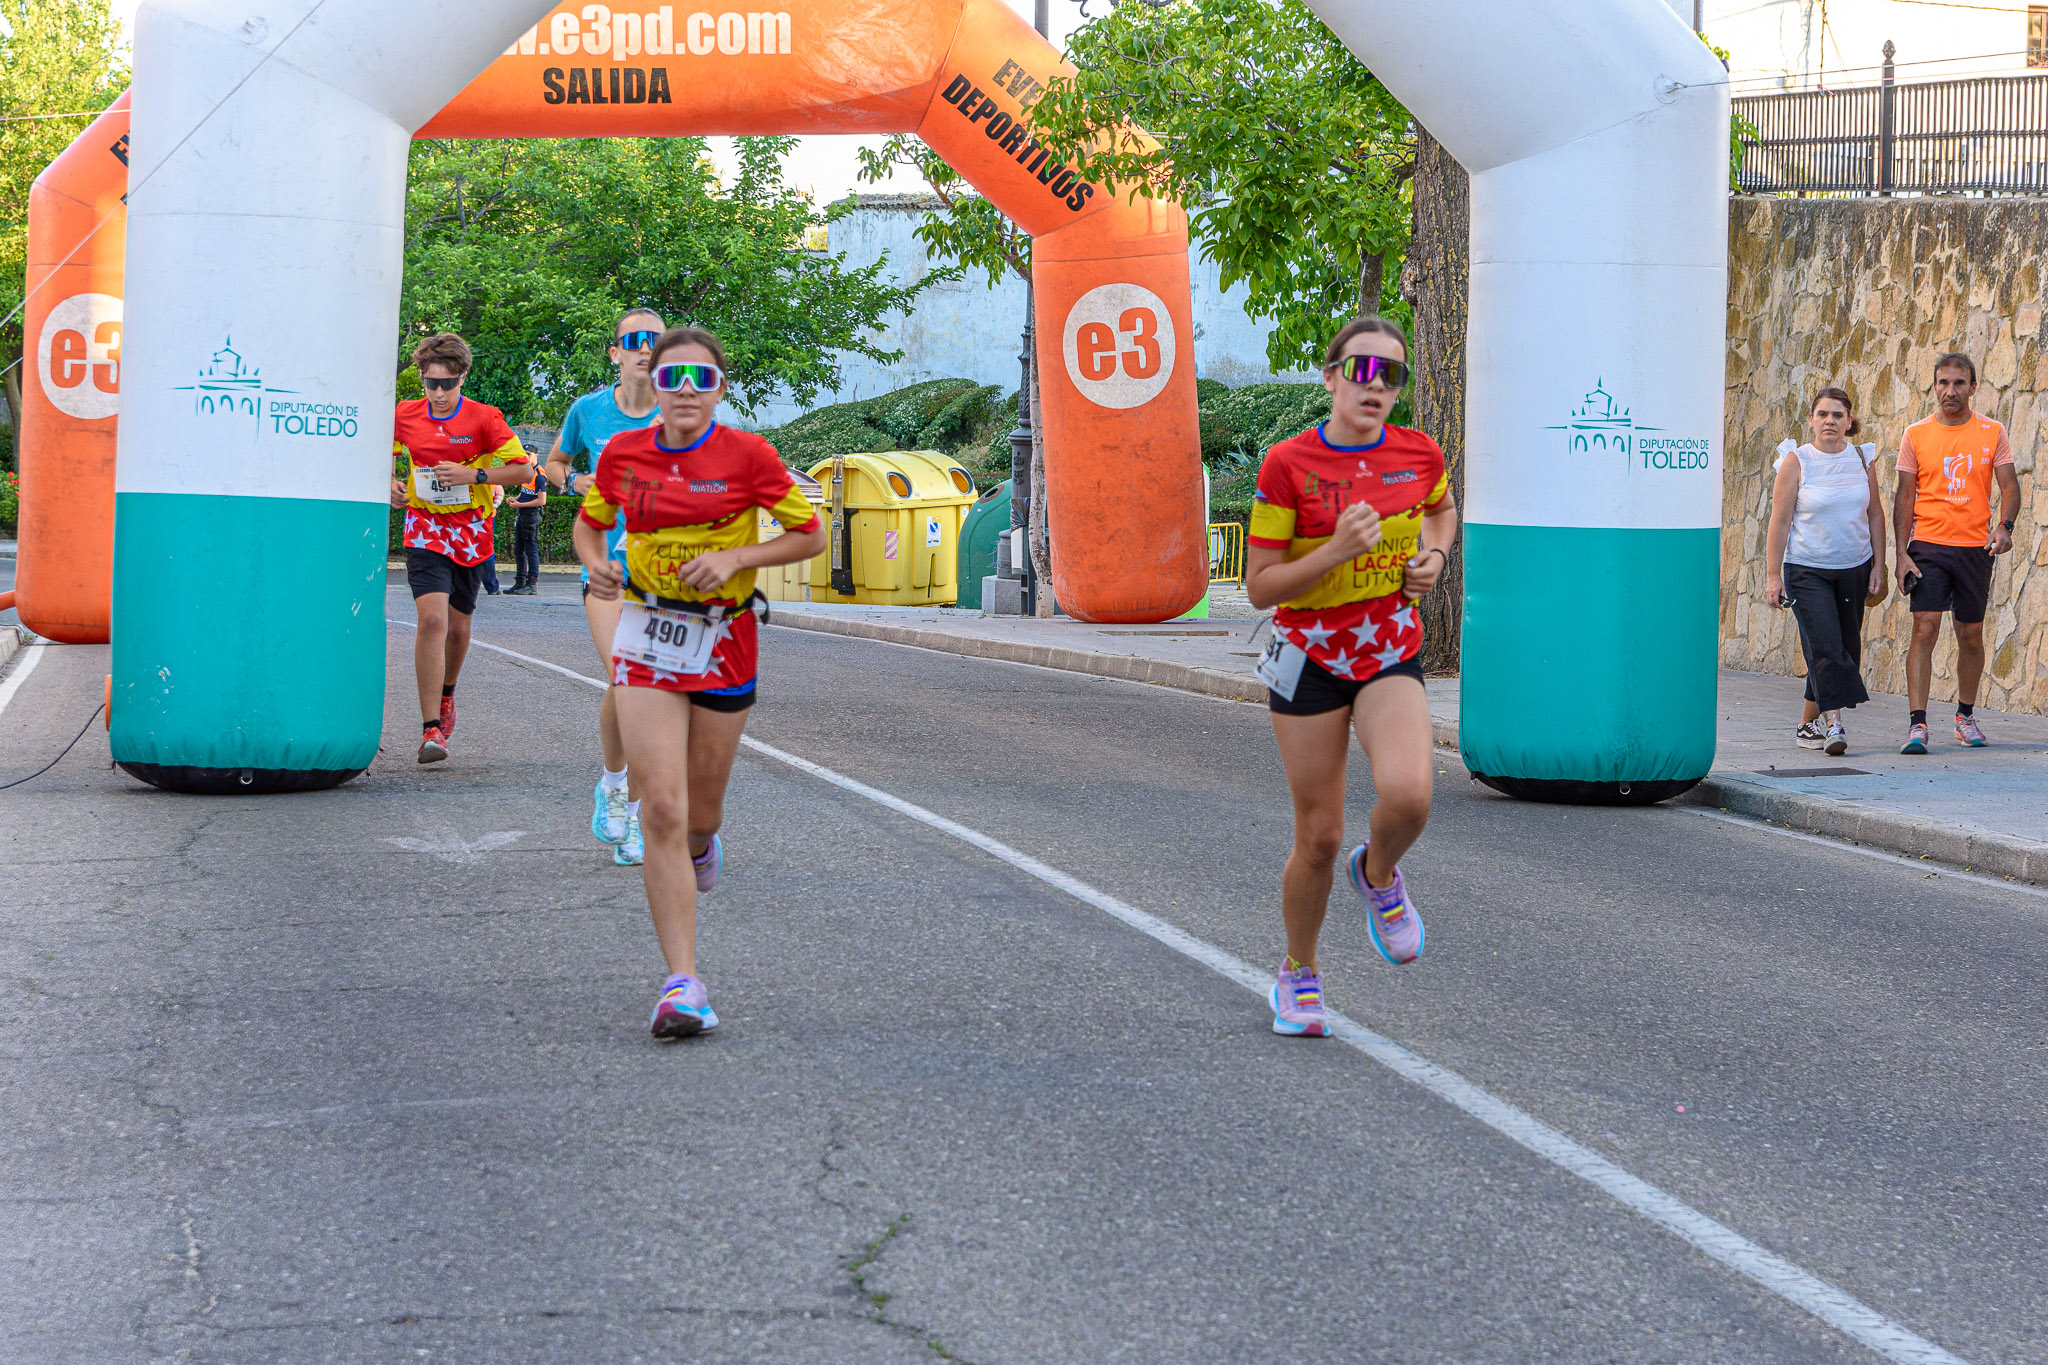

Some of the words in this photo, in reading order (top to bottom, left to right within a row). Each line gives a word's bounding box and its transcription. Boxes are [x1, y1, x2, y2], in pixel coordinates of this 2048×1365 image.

[543, 67, 672, 104] SALIDA
[941, 73, 1094, 212] DEPORTIVOS
[1077, 307, 1161, 381] e3
[270, 402, 344, 416] DIPUTACIÓN
[346, 406, 358, 417] DE
[270, 414, 358, 438] TOLEDO
[1640, 437, 1699, 450] DIPUTACIÓN
[1701, 440, 1709, 450] DE
[1639, 451, 1709, 469] TOLEDO
[1353, 552, 1409, 572] LACAS
[644, 617, 688, 647] 490
